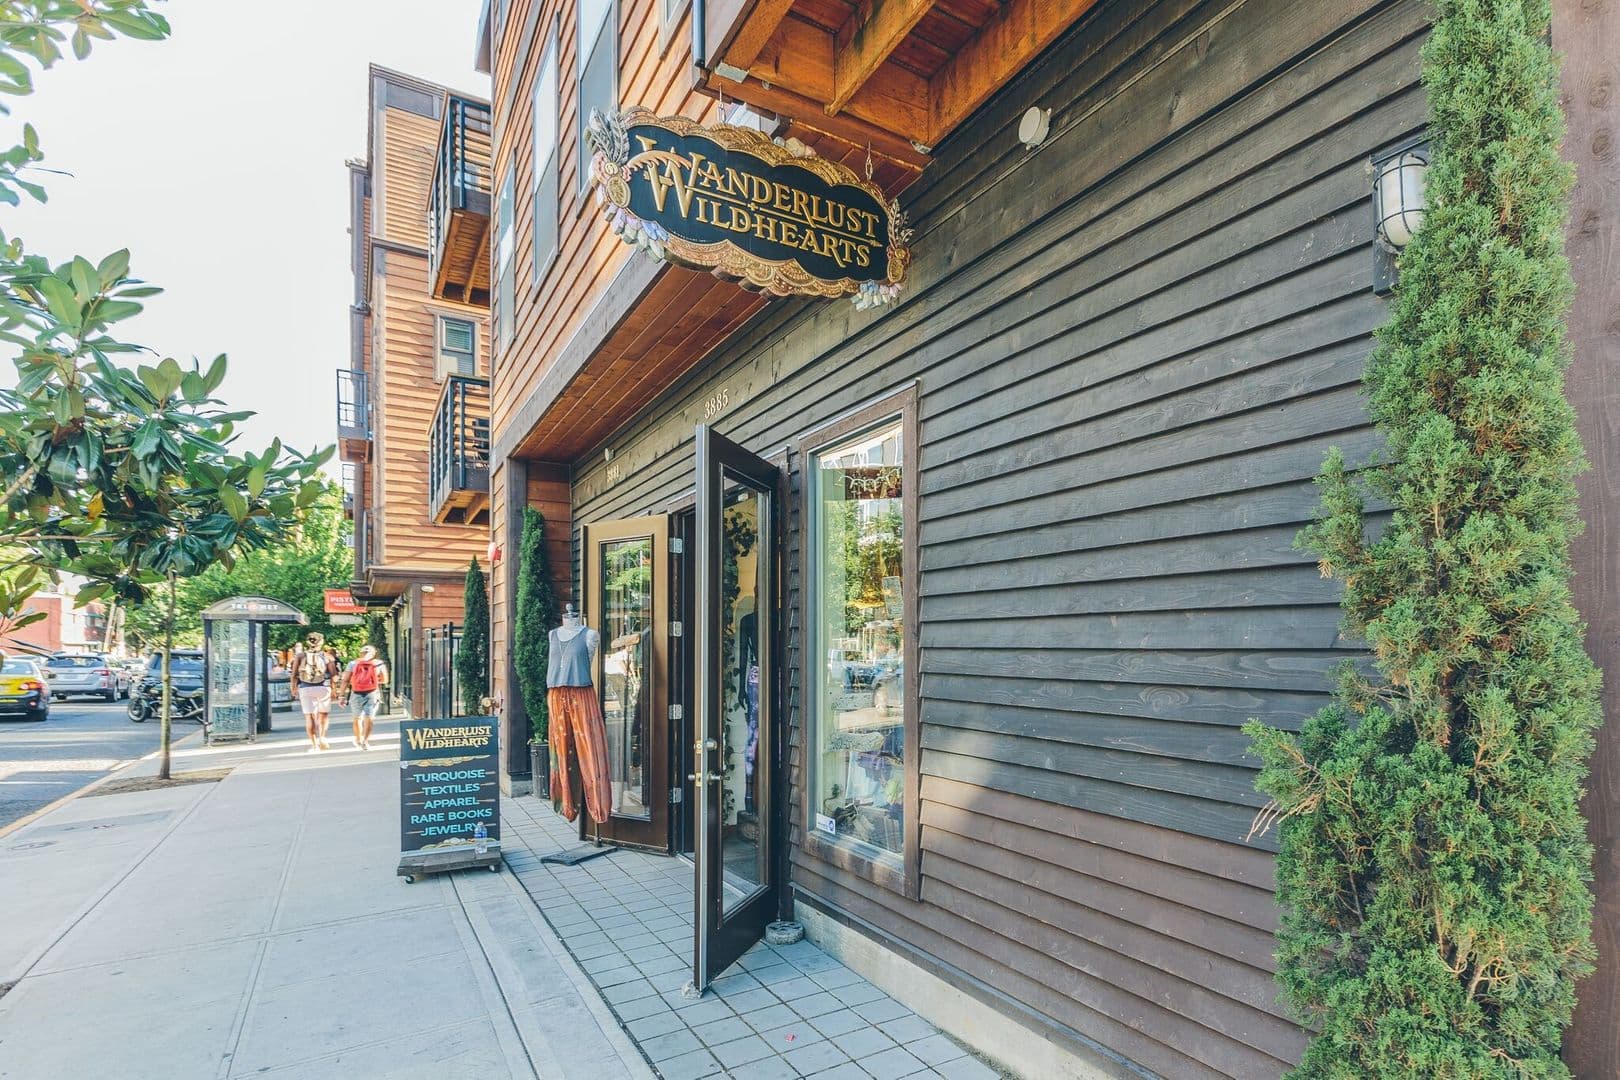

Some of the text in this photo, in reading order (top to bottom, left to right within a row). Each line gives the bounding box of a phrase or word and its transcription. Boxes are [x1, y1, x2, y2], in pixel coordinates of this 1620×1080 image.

[635, 134, 880, 238] WANDERLUST
[704, 388, 728, 419] 3885
[406, 726, 492, 746] WANDERLUST
[407, 733, 489, 750] WILDHEARTS
[413, 769, 486, 783] TURQUOISE
[422, 783, 480, 796] TEXTILES
[424, 796, 480, 810] APPAREL
[411, 808, 493, 825] RARE BOOKS
